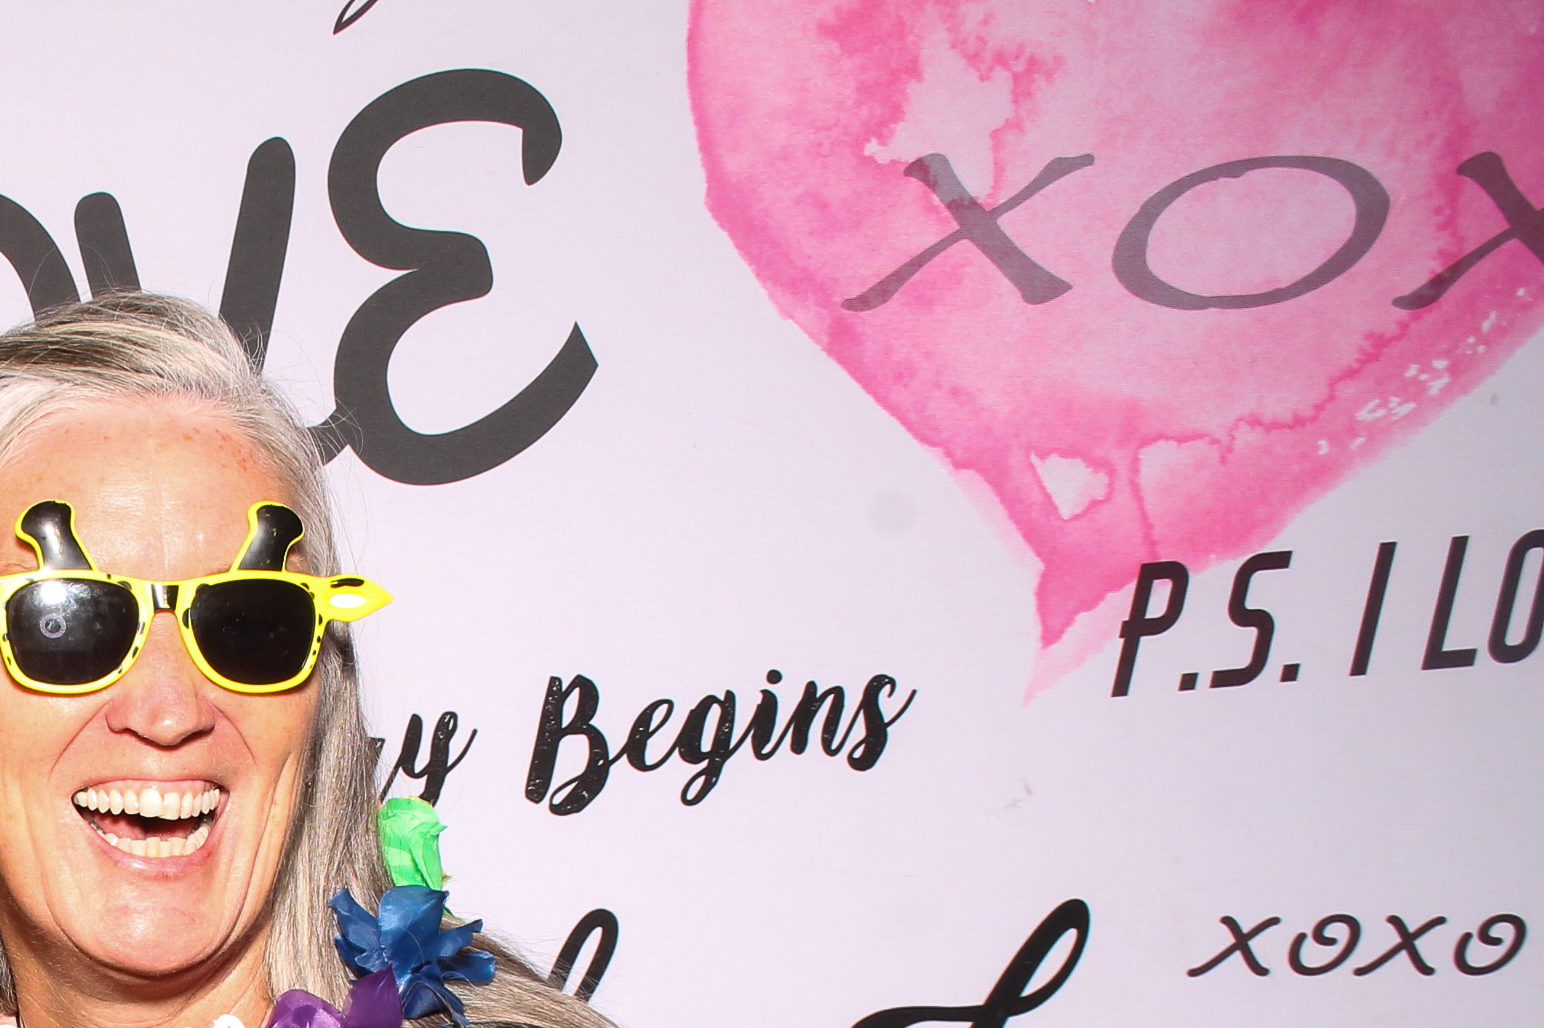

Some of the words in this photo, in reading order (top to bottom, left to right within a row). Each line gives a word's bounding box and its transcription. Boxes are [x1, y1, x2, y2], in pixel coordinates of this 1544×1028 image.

[1111, 550, 1301, 698] P.S.
[1349, 541, 1398, 677] I
[525, 669, 917, 817] Begins
